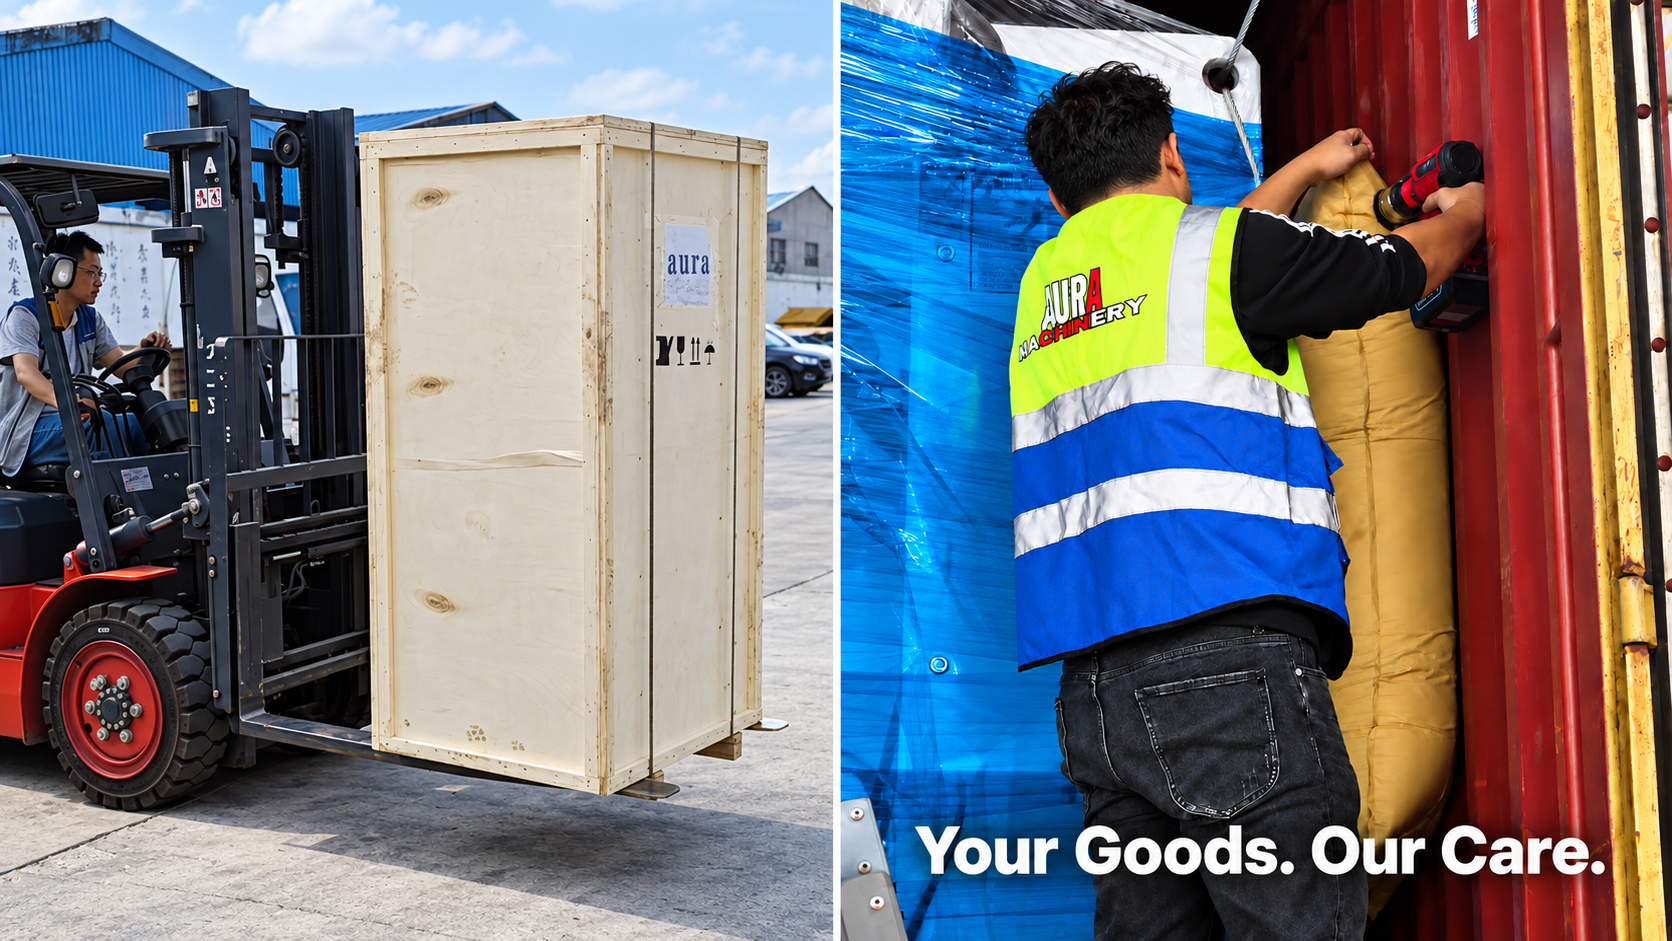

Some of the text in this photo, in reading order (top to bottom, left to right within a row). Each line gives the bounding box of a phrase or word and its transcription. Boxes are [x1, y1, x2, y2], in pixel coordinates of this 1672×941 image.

[667, 253, 710, 275] aura
[1018, 293, 1148, 363] MACHINERY
[1041, 266, 1103, 331] AURA
